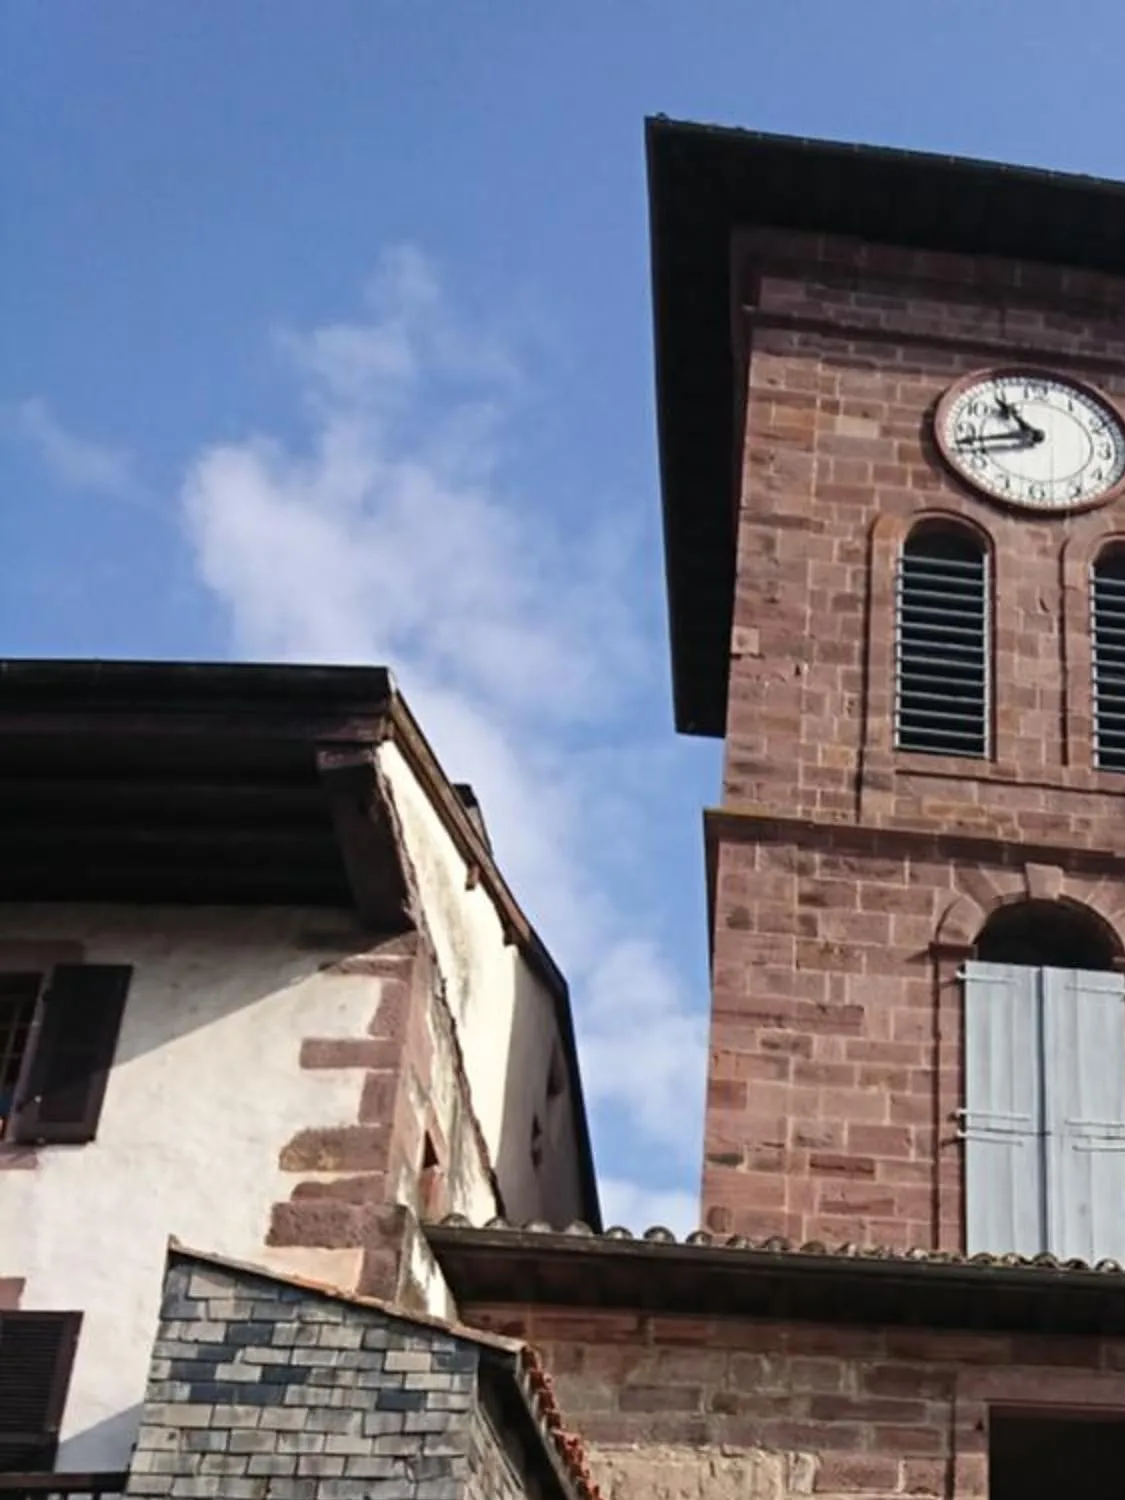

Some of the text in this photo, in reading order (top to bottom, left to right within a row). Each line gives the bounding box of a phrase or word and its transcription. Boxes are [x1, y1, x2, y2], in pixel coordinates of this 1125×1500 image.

[1023, 381, 1049, 401] 12
[966, 400, 989, 416] 10
[1067, 398, 1074, 412] 1
[957, 421, 977, 443] 9
[1089, 418, 1109, 434] 2
[1097, 442, 1112, 460] 3
[995, 473, 1010, 489] 7
[1091, 467, 1103, 482] 4
[1029, 482, 1045, 500] 6
